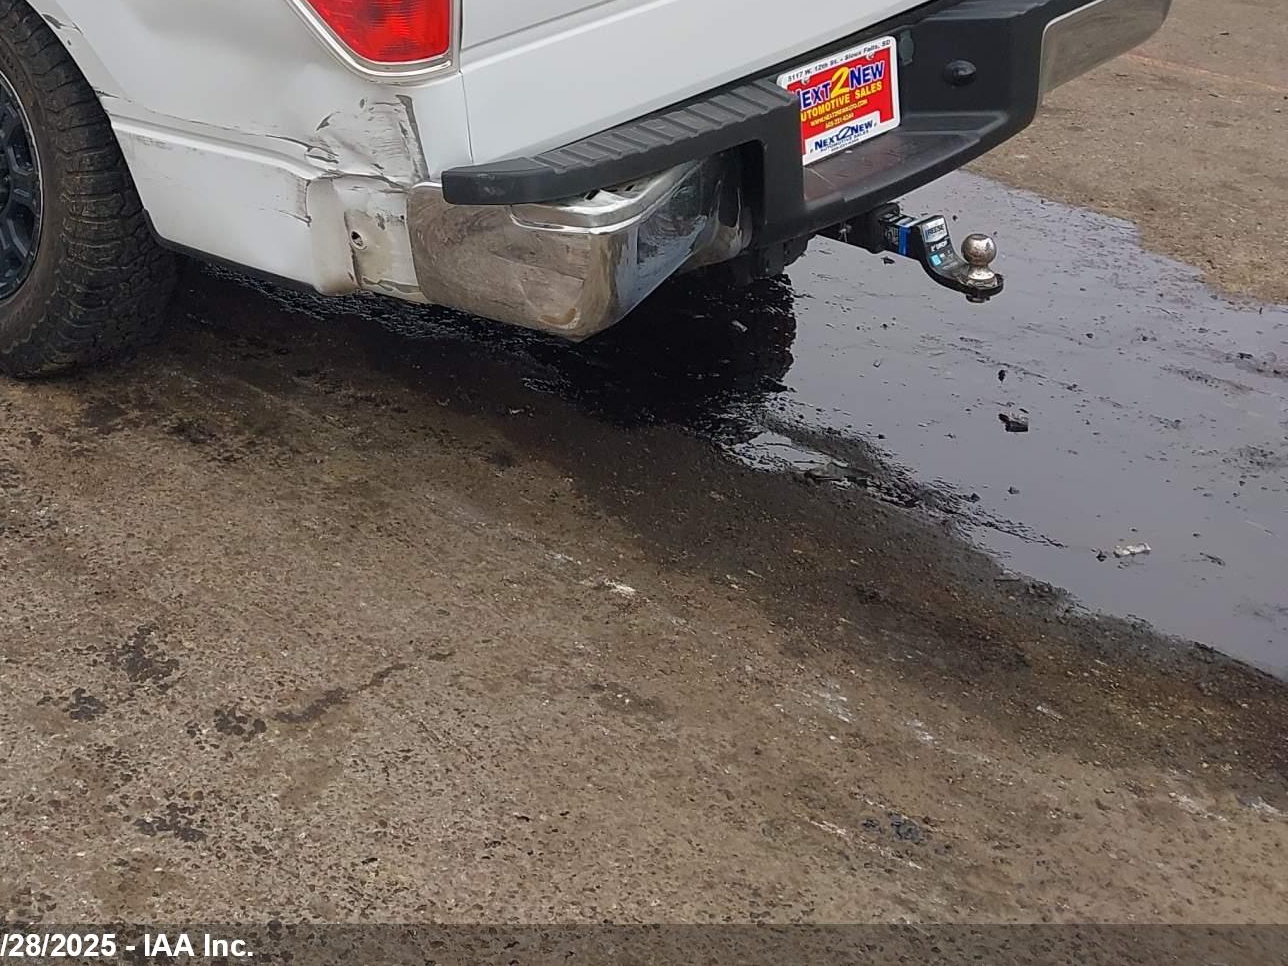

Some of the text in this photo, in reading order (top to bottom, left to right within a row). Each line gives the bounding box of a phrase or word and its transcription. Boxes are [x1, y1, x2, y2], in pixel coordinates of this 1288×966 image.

[788, 72, 803, 81] 5117
[814, 62, 829, 71] 12th
[845, 51, 862, 61] Sioux
[882, 39, 891, 47] SD
[800, 94, 850, 122] UTOMOTIVE
[855, 81, 882, 100] SALES
